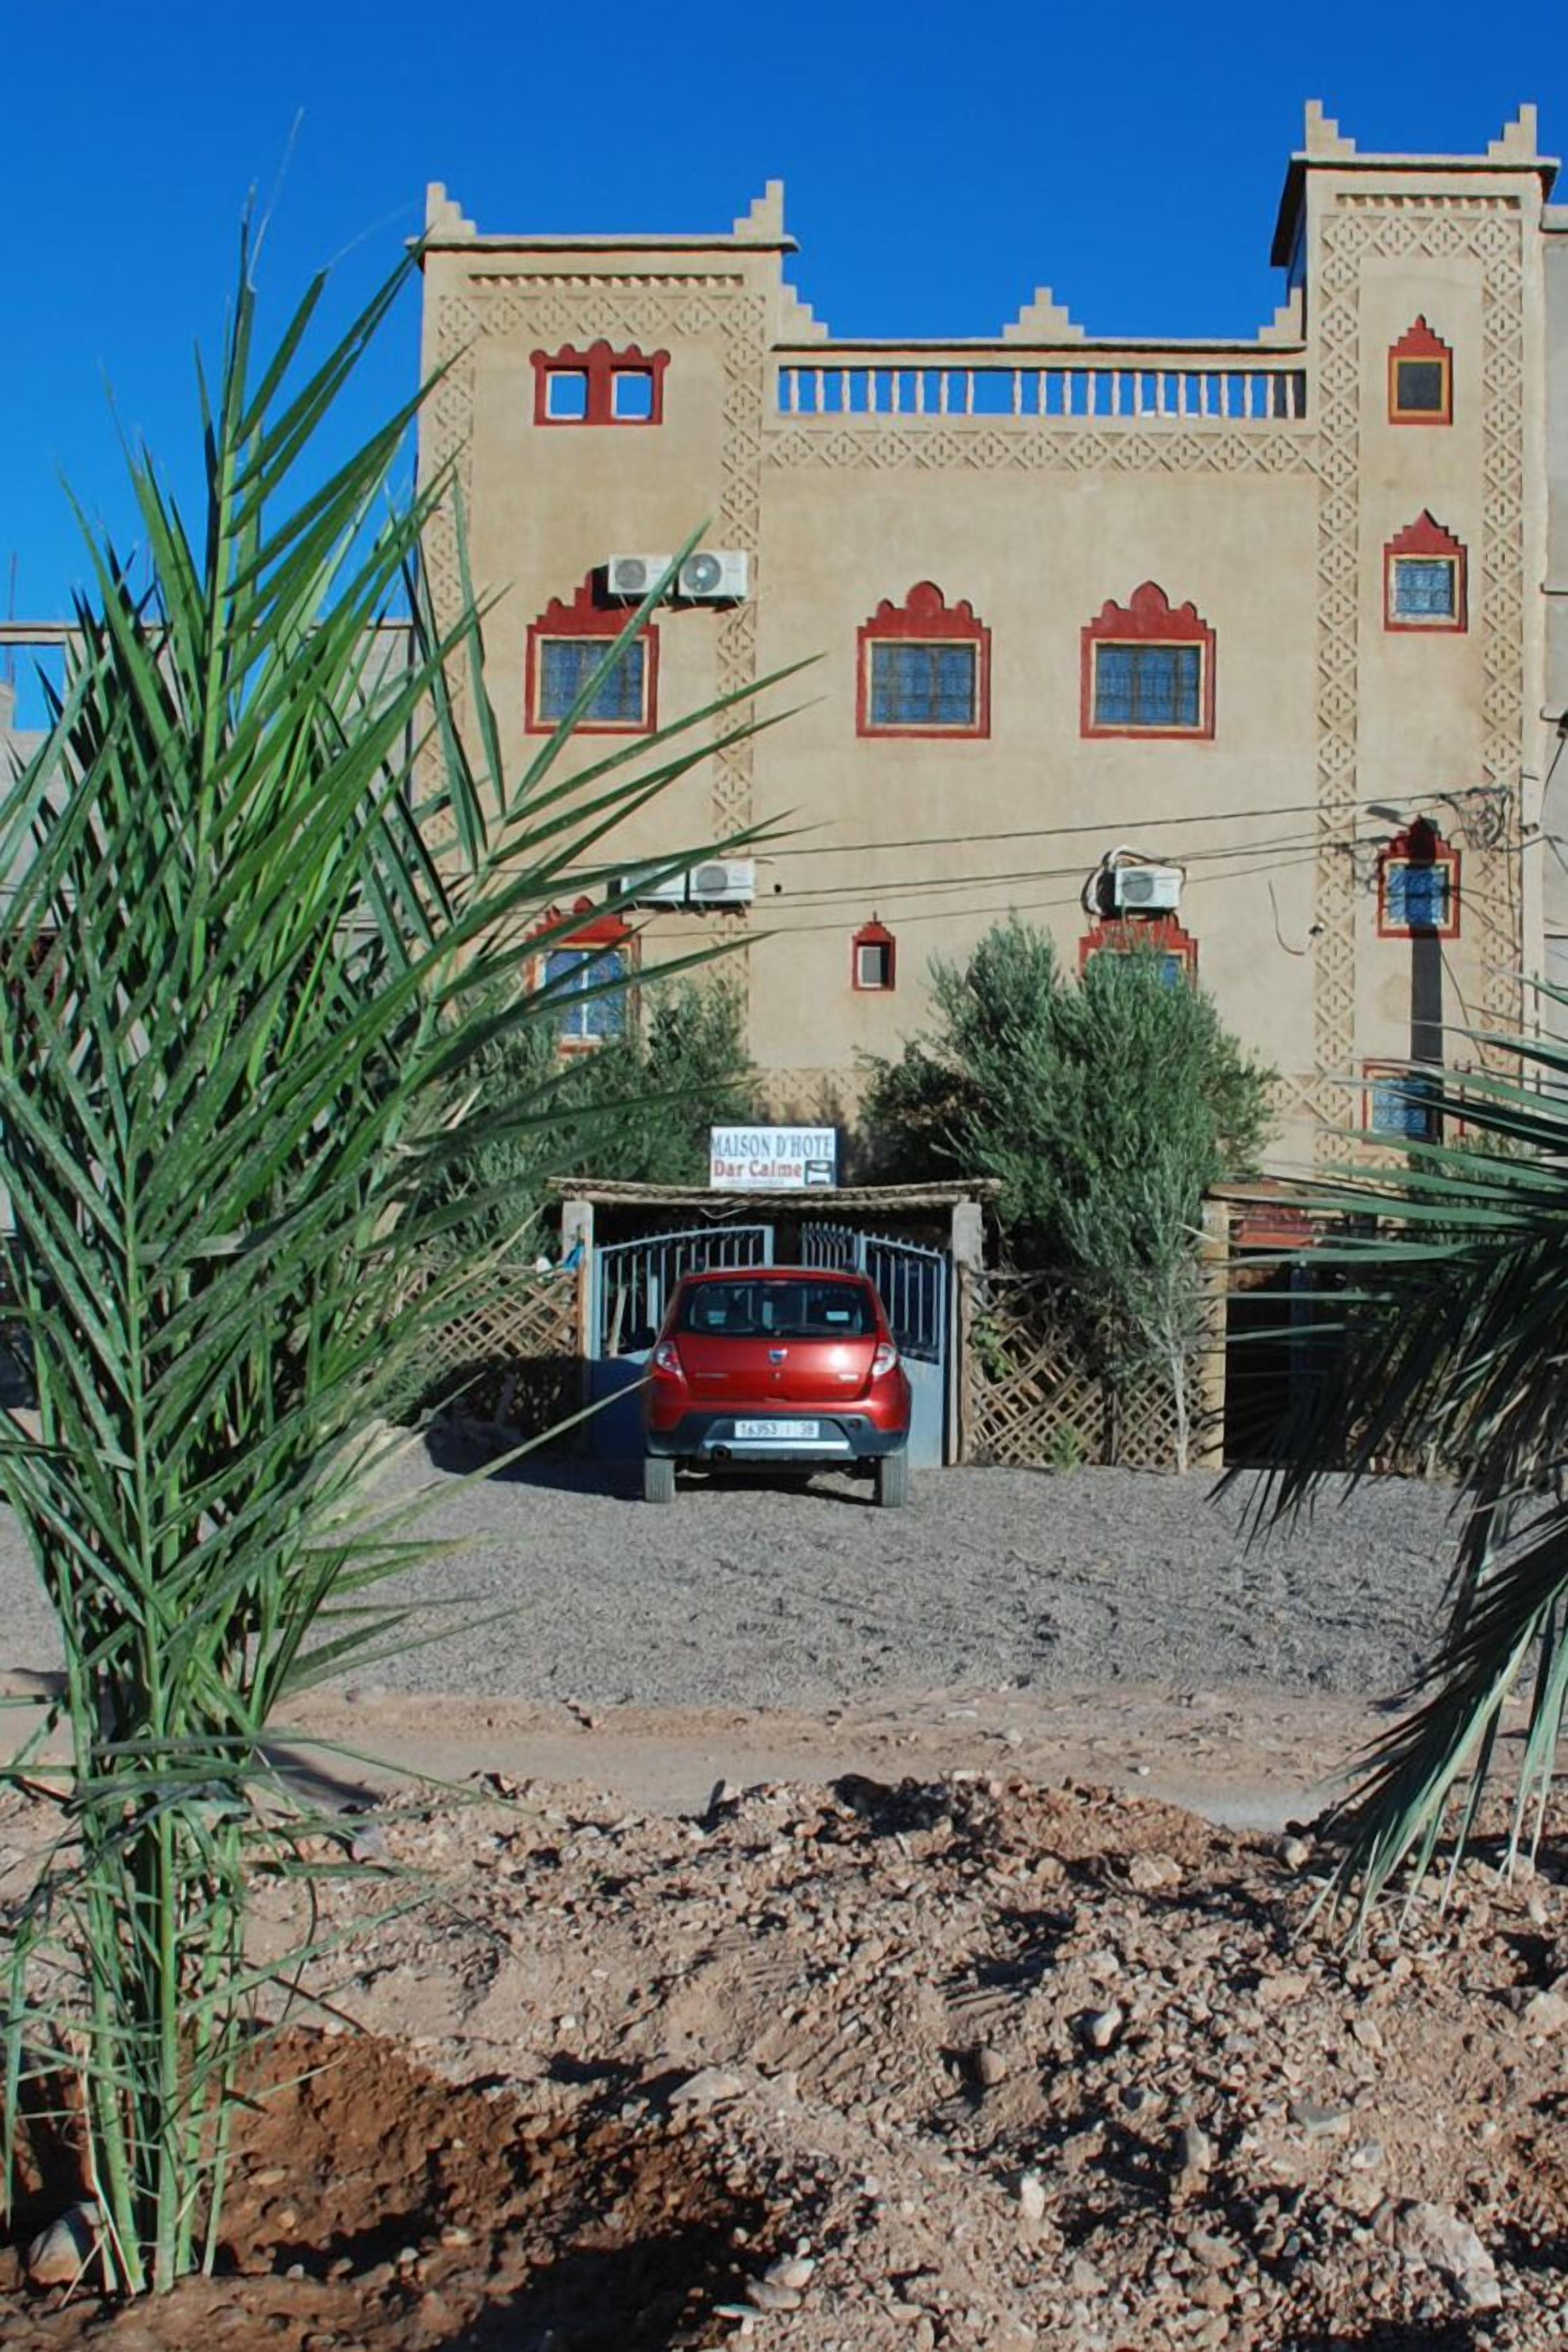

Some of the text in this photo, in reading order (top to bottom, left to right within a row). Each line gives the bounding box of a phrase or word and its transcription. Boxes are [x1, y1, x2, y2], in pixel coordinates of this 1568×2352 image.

[712, 1134, 771, 1157] MAISON
[714, 1159, 802, 1177] Dar Calme
